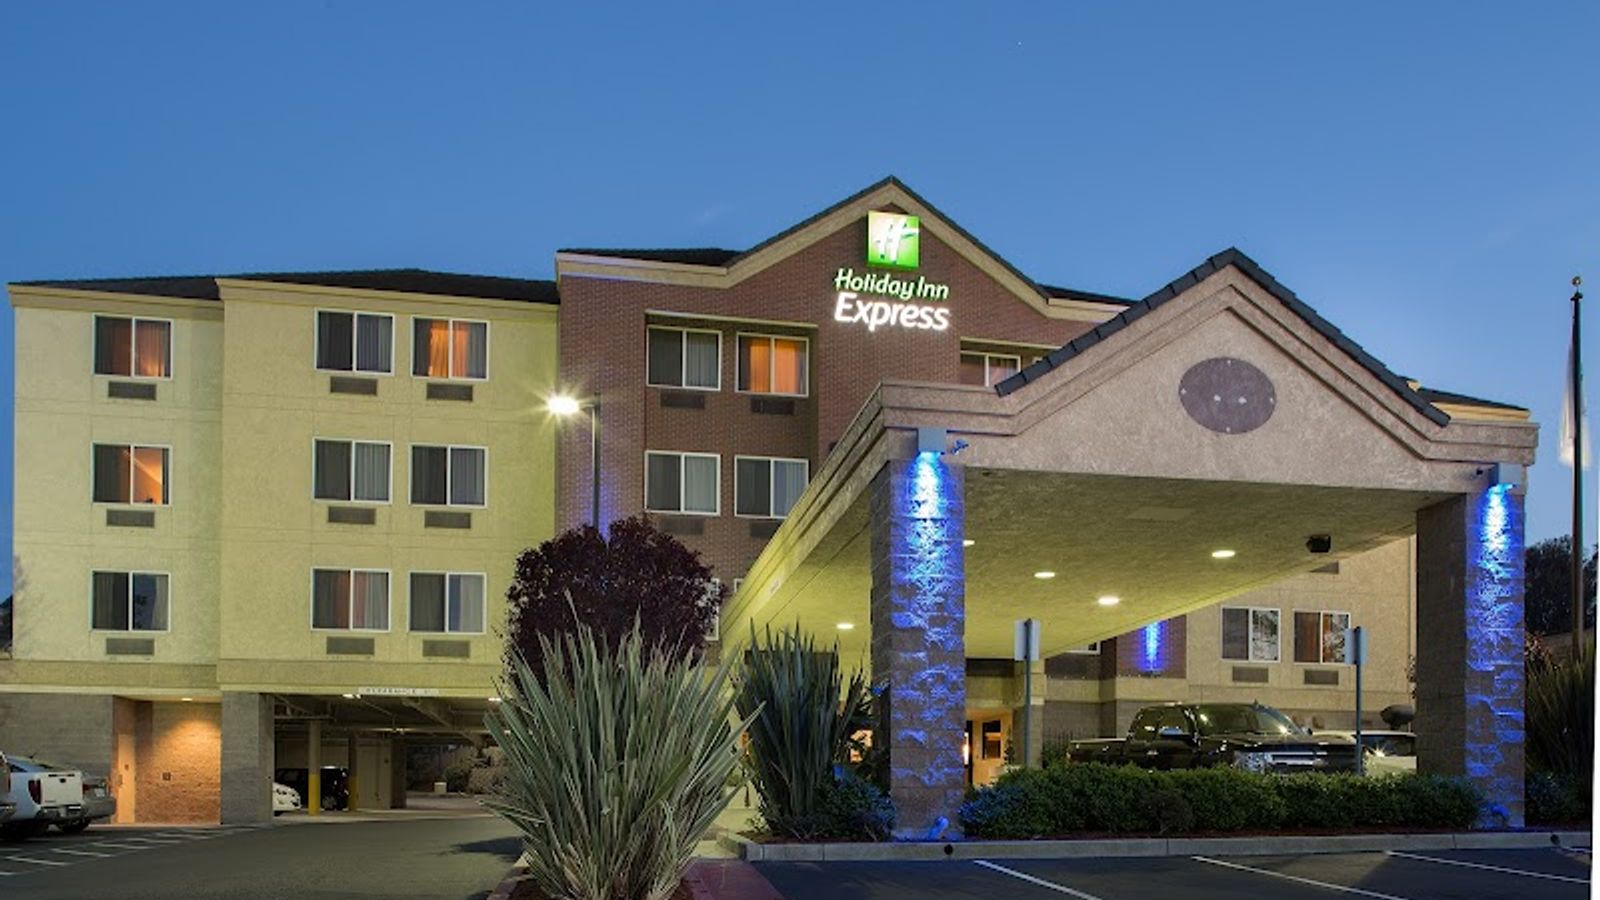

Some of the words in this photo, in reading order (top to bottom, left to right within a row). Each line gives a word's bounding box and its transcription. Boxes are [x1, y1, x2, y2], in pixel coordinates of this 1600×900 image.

[834, 268, 914, 300] Holiday
[917, 276, 949, 299] Inn
[834, 291, 950, 332] Express
